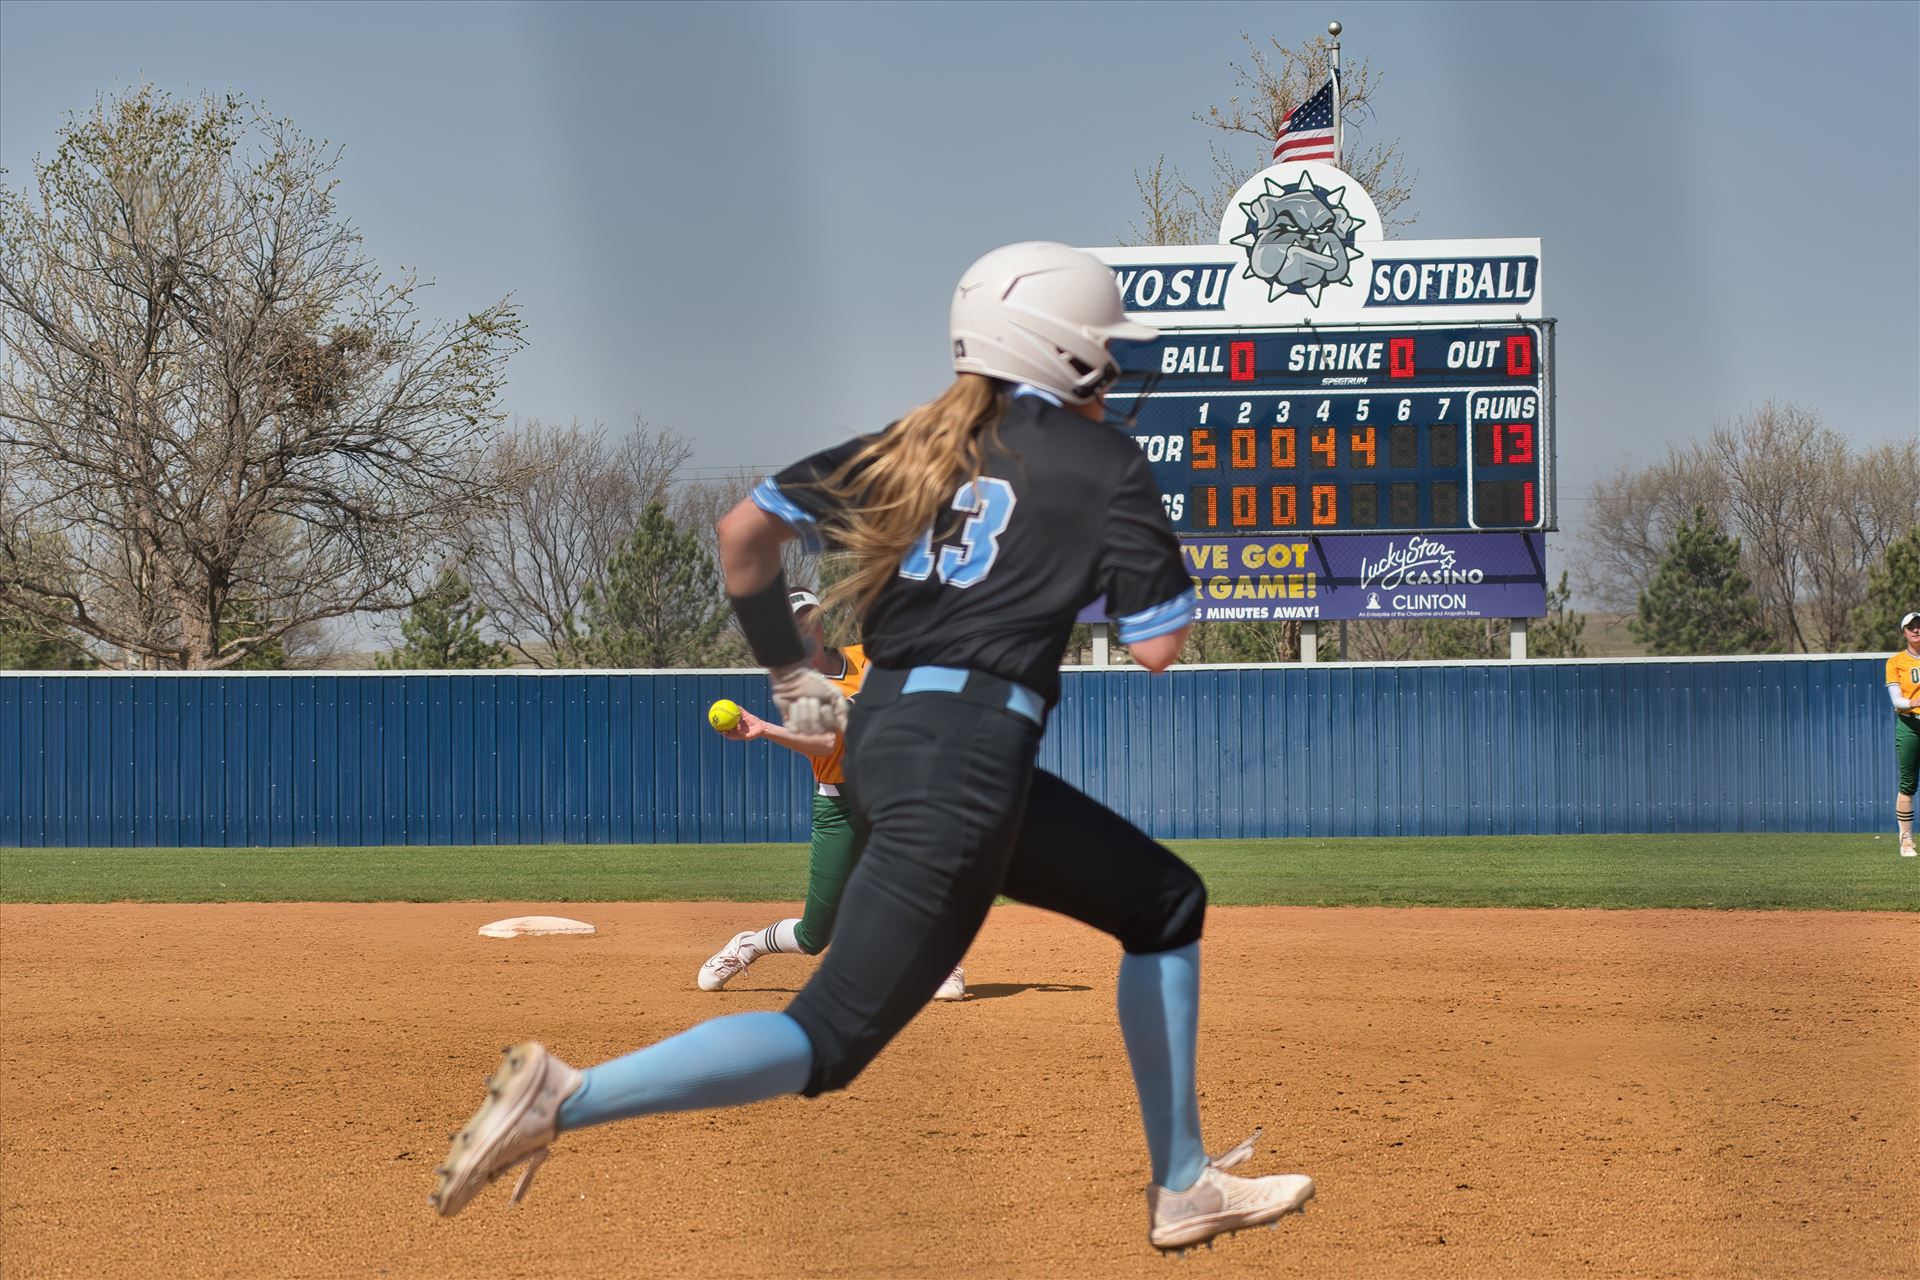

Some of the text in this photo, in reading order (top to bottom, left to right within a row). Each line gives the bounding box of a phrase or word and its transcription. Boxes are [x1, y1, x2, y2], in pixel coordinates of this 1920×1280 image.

[1373, 261, 1534, 301] SOFTBALL
[1161, 336, 1531, 381] BALL 0 STRIKE 0 OUT 0
[1320, 376, 1369, 386] SPECTRUM
[1199, 397, 1536, 424] 1 2 3 4 5 6 7 RUNS
[1130, 424, 1533, 469] TOR 5 0 0 4 4 13
[1207, 487, 1217, 526] 1
[1232, 486, 1257, 526] 0
[1272, 486, 1297, 525] 0
[1312, 485, 1337, 525] 0
[1524, 482, 1533, 521] 1
[1241, 543, 1309, 569] GOT
[1361, 536, 1455, 591] Lucky Star
[1208, 572, 1317, 600] GAME!
[1405, 569, 1484, 586] CASINO
[1206, 606, 1269, 619] MINUTES
[1273, 605, 1320, 619] AWAY!
[1392, 593, 1467, 610] CLINTON
